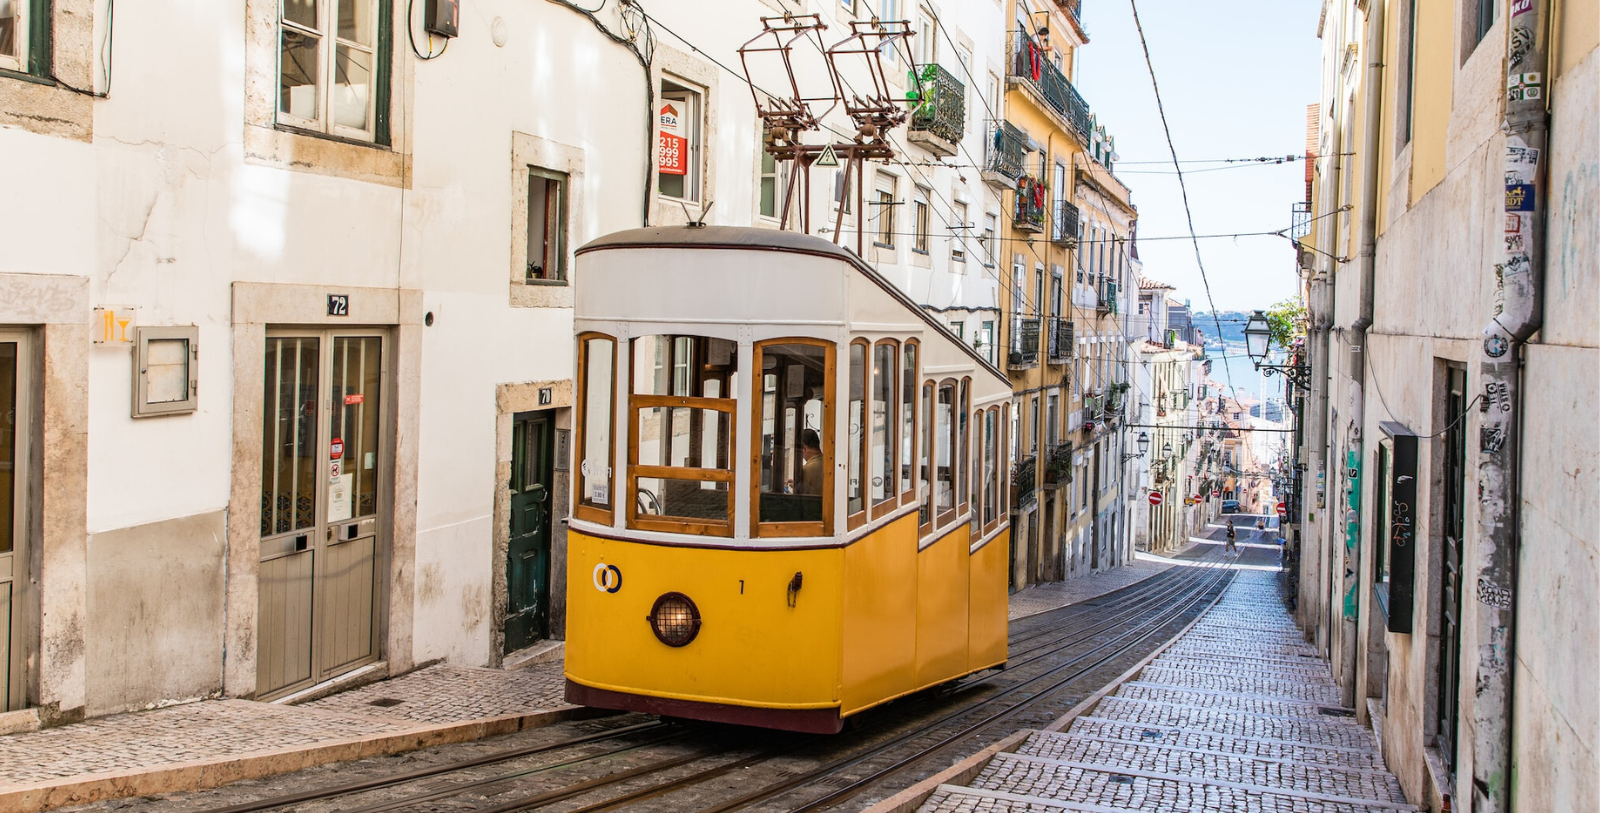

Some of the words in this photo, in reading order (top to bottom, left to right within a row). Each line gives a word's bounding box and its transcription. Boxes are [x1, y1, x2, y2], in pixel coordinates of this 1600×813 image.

[660, 116, 677, 125] ERA
[660, 137, 679, 148] 215
[660, 147, 679, 158] 999
[660, 157, 679, 168] 995
[332, 296, 346, 315] 72
[541, 389, 551, 404] 70
[738, 579, 745, 595] 1
